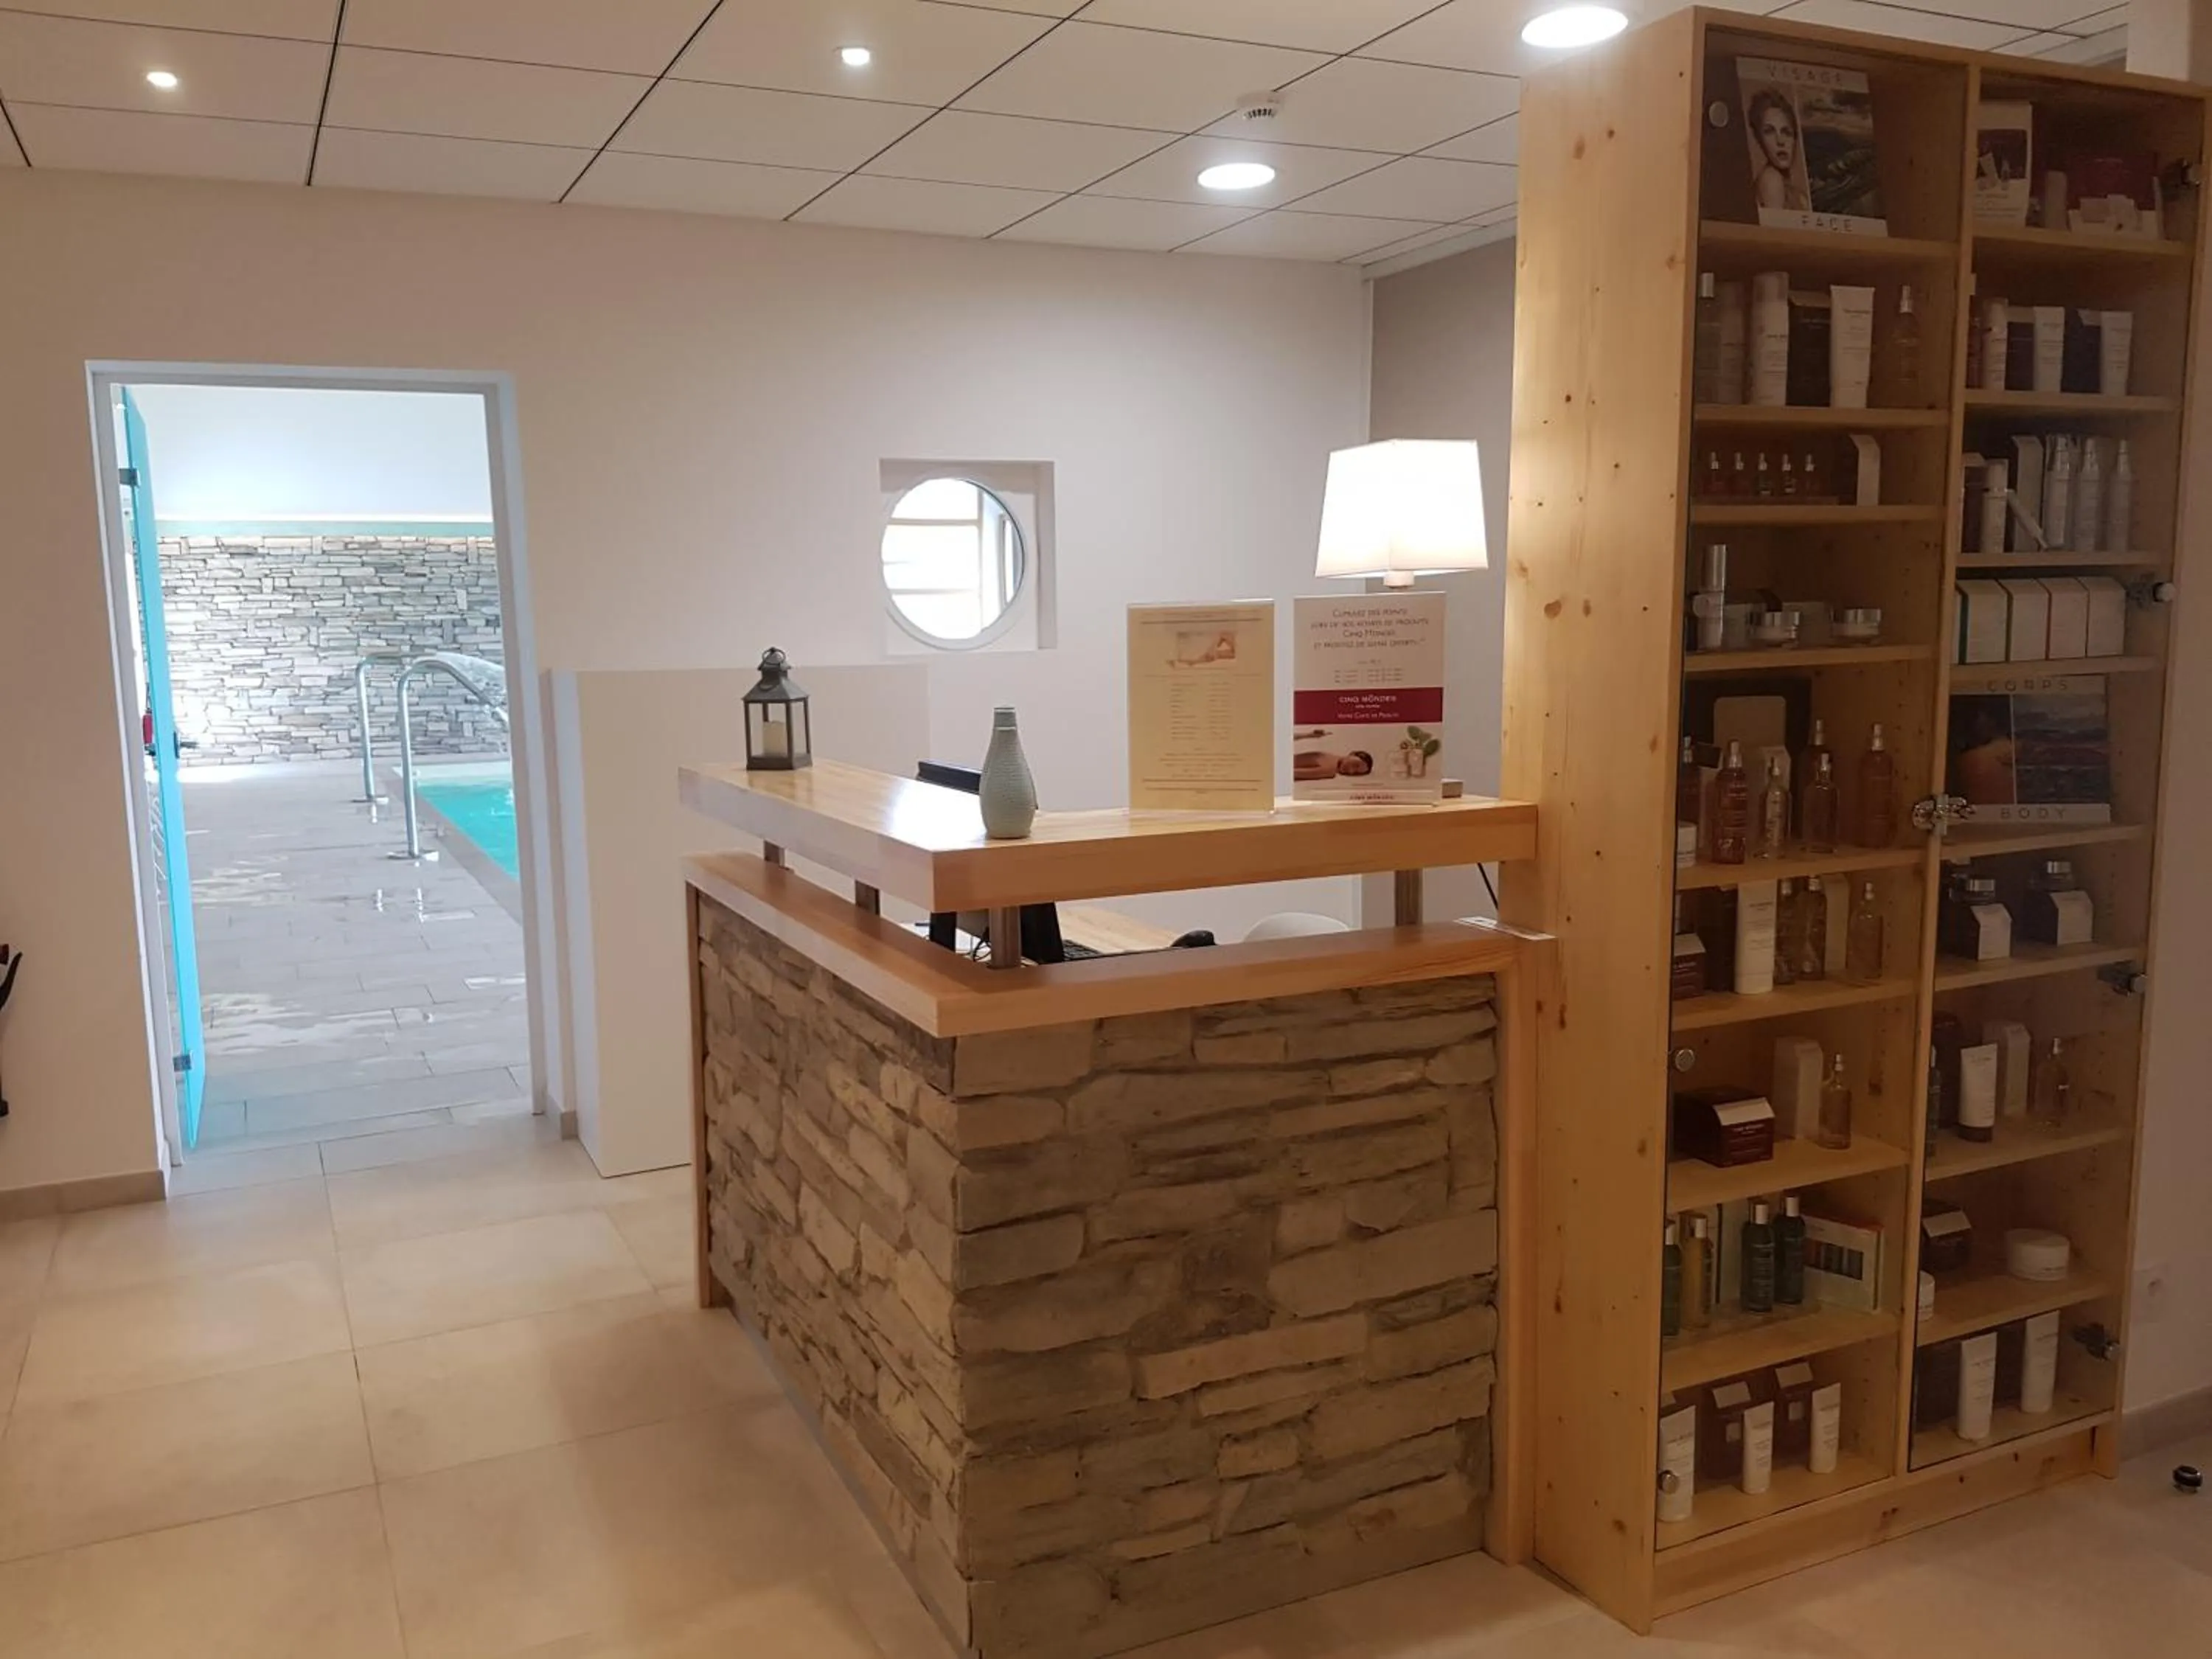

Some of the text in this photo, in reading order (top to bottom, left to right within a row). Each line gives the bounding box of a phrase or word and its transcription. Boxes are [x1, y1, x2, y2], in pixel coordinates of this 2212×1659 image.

[1766, 64, 1843, 86] VISAGE
[1801, 215, 1853, 232] FACE
[1986, 679, 2067, 692] CORPS
[2000, 807, 2065, 819] BODY
